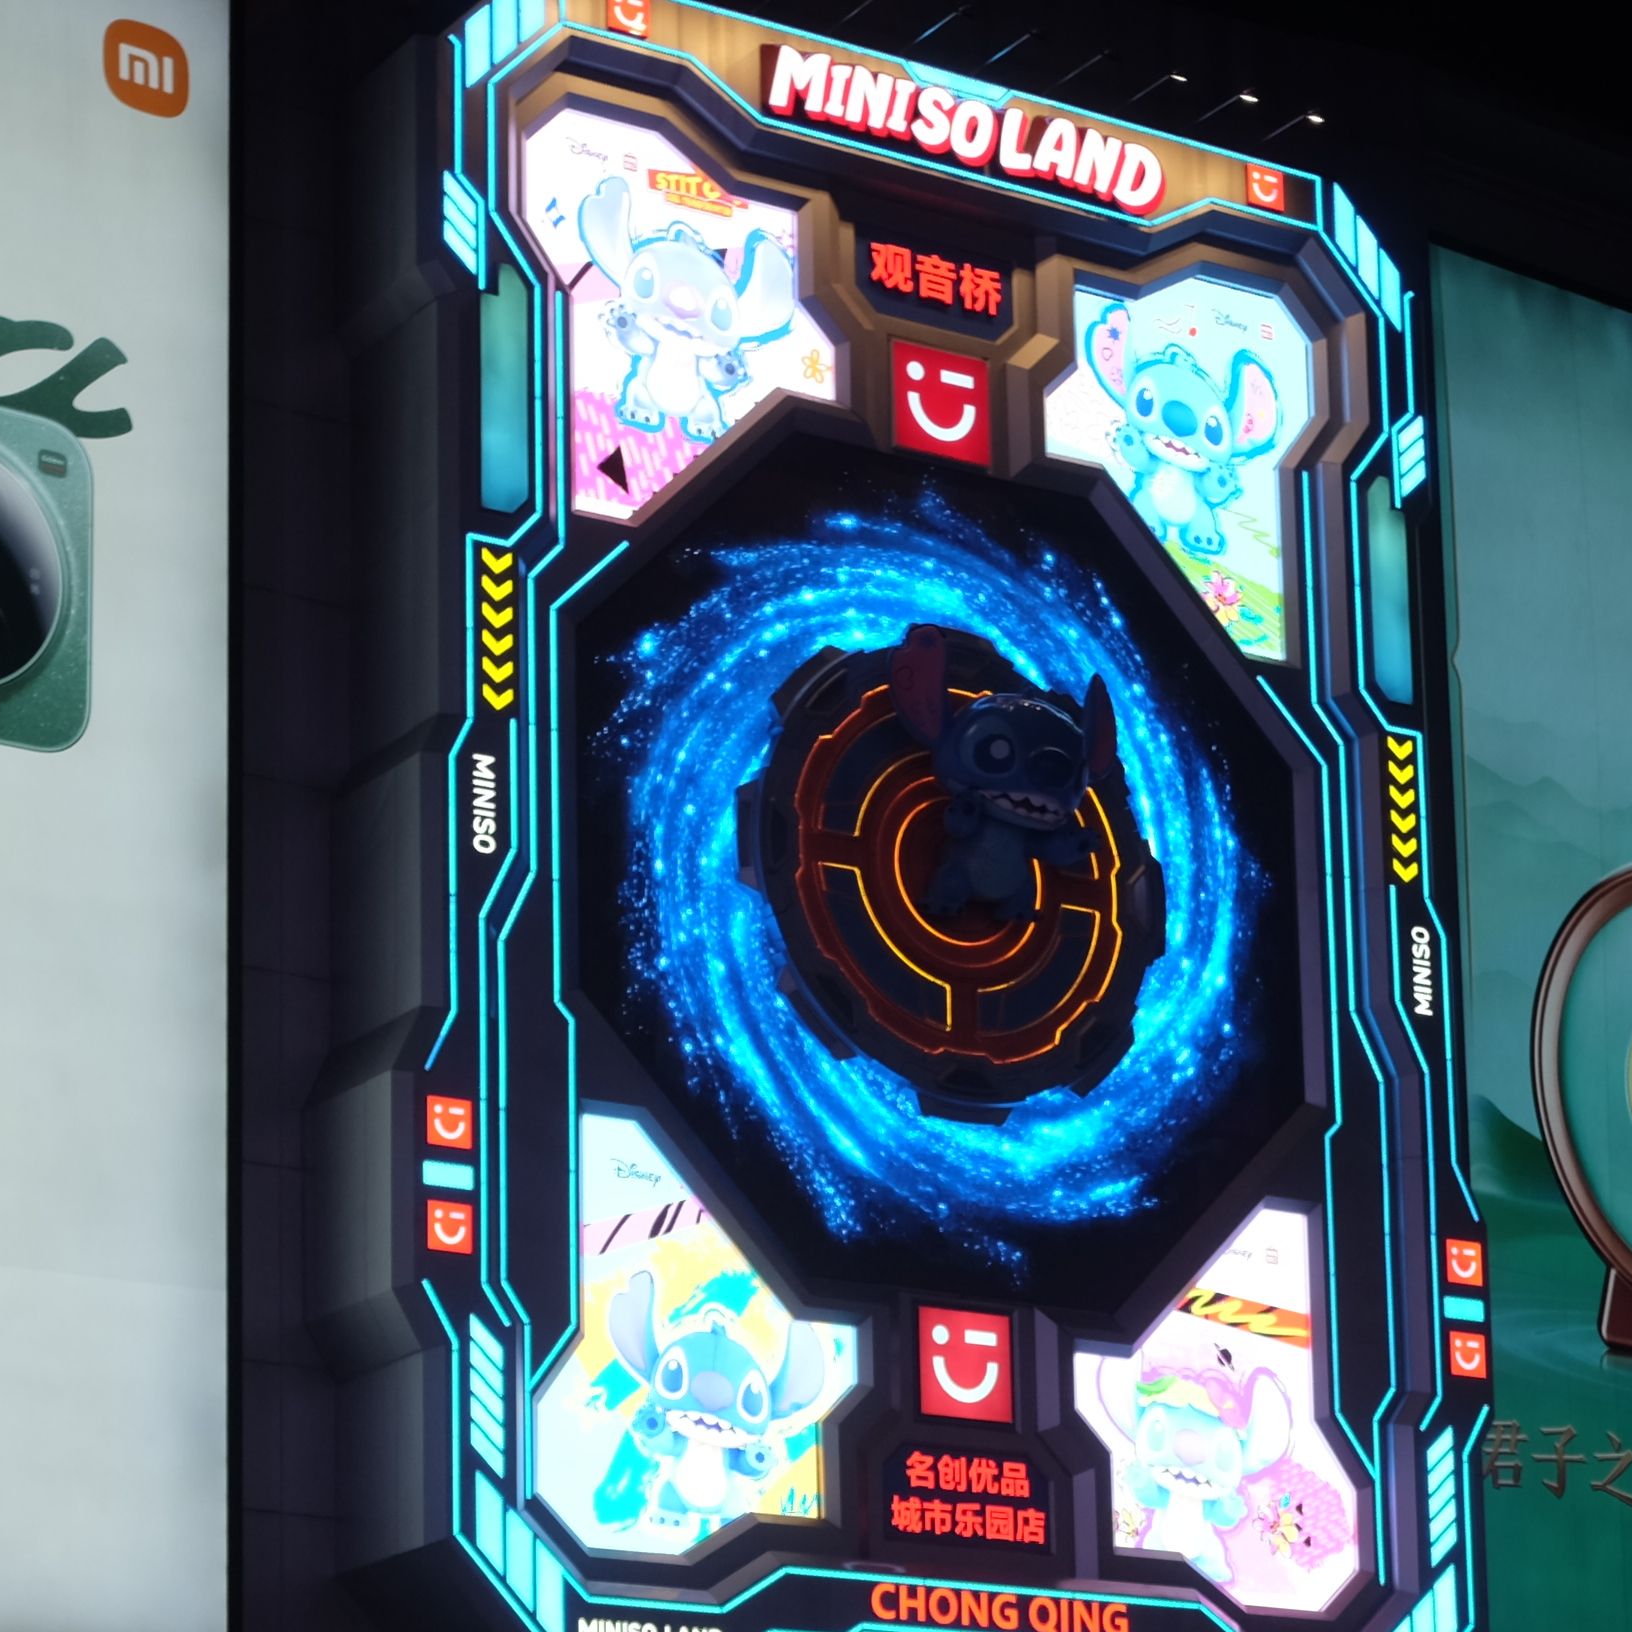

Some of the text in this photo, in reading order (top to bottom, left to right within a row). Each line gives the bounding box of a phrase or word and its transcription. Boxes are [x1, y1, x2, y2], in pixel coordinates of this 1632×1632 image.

[766, 44, 1165, 213] MINISO LAND
[870, 242, 1002, 316] 观音桥
[471, 752, 497, 855] MINISO
[1412, 924, 1432, 1017] MINISO
[906, 1451, 1031, 1498] 名创优品
[891, 1494, 1046, 1545] 城市乐园店
[870, 1582, 1020, 1631] CHONG
